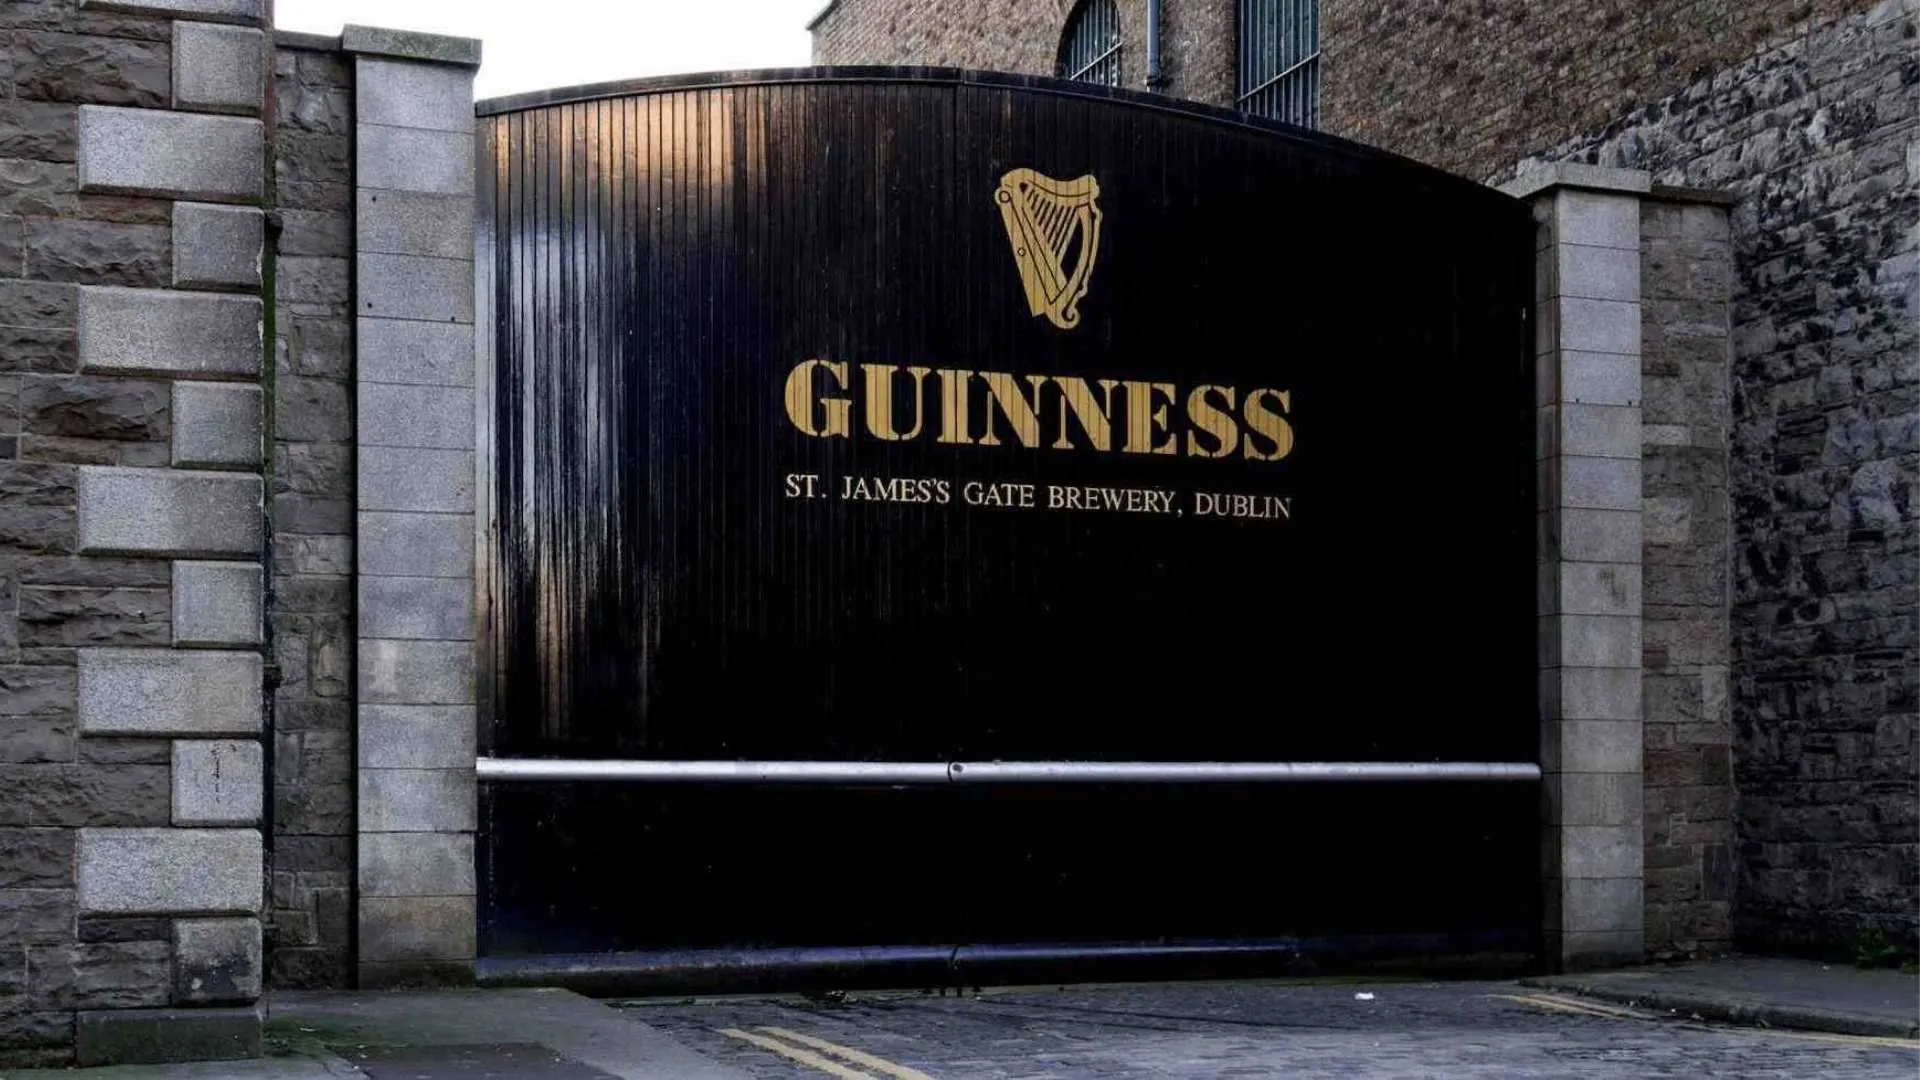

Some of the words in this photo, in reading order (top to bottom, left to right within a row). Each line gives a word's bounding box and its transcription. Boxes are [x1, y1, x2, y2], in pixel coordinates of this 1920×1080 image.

[783, 358, 1295, 462] GUINNESS
[784, 472, 828, 500] ST.
[841, 475, 951, 505] JAMES'S
[963, 481, 1036, 508] GATE
[1047, 485, 1184, 517] BREWERY,
[1194, 492, 1293, 521] DUBLIN
